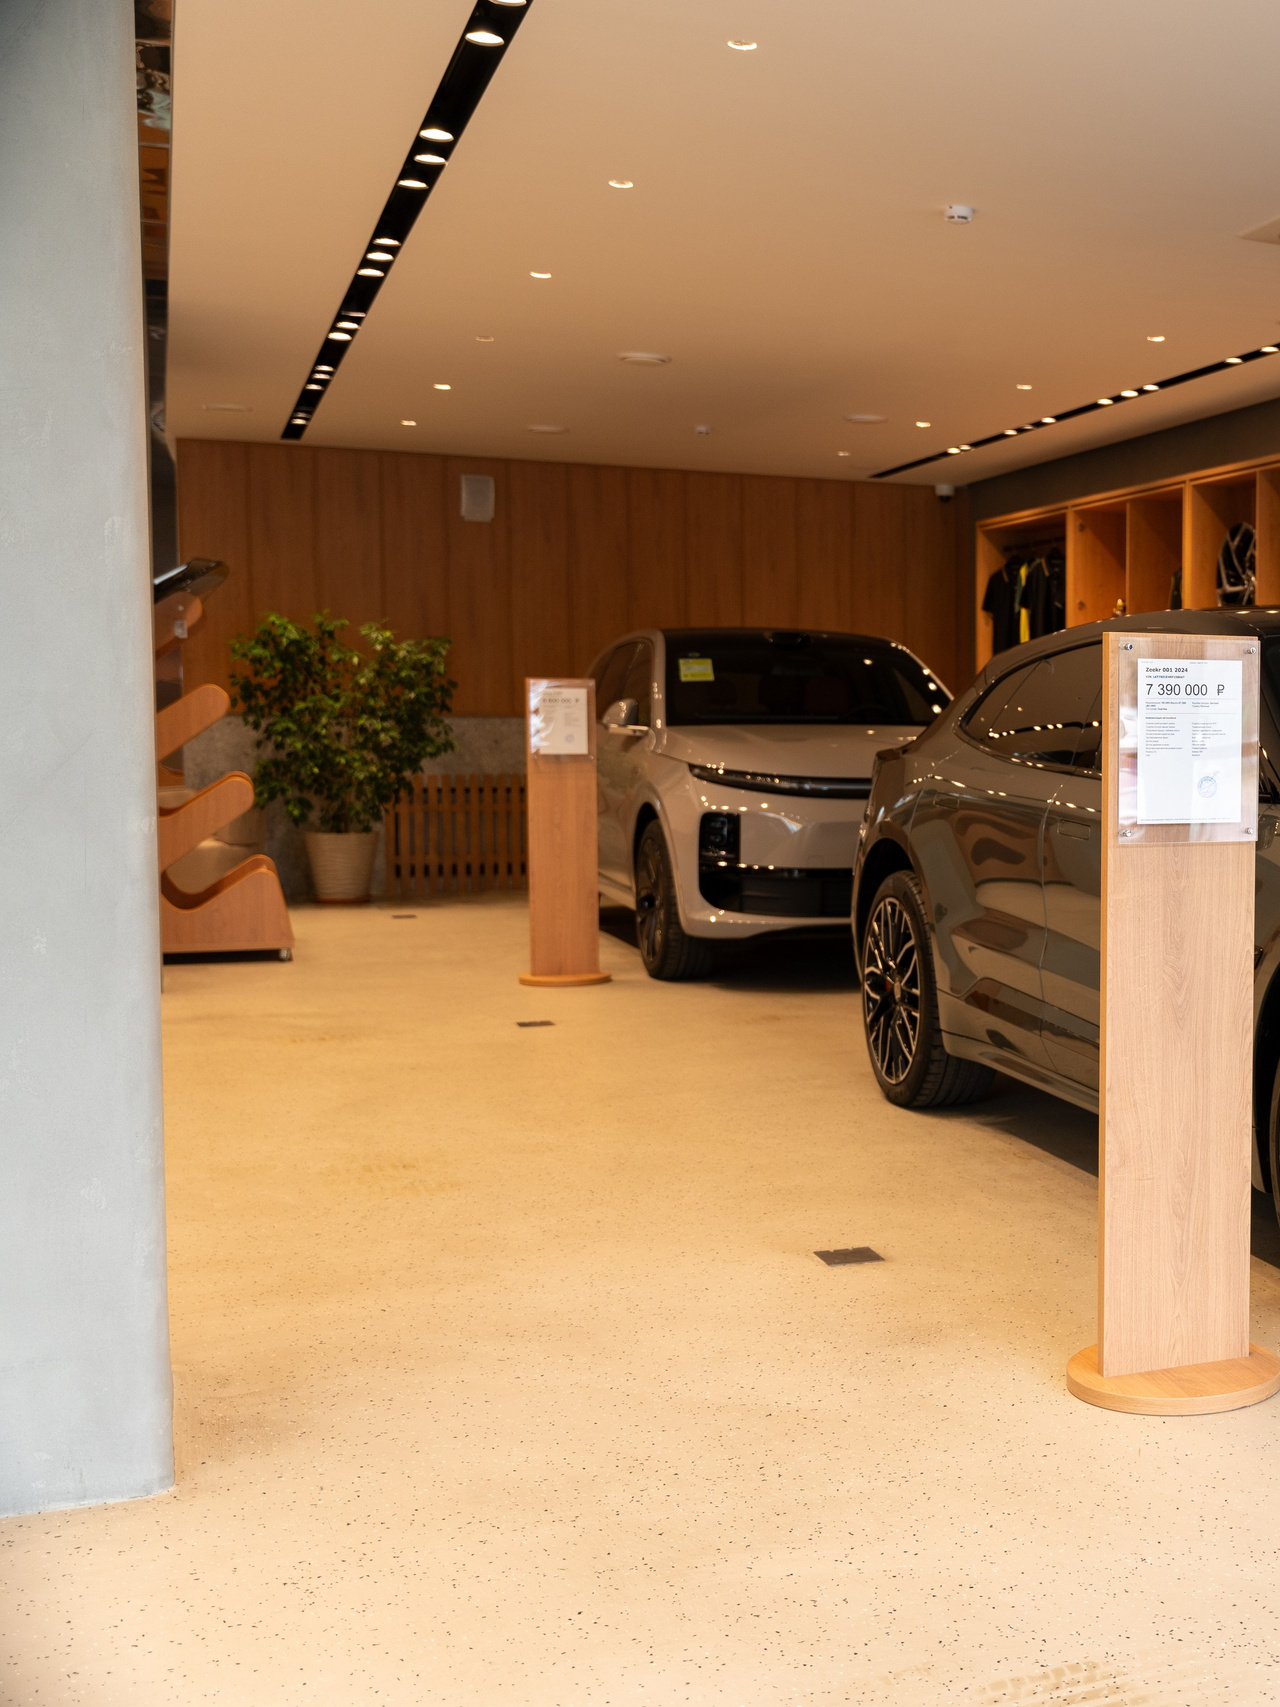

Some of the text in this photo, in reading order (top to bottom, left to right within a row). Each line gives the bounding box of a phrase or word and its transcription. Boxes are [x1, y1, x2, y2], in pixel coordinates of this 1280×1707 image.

[1145, 683, 1153, 696] 7
[1157, 683, 1181, 696] 390
[1184, 683, 1208, 696] 000
